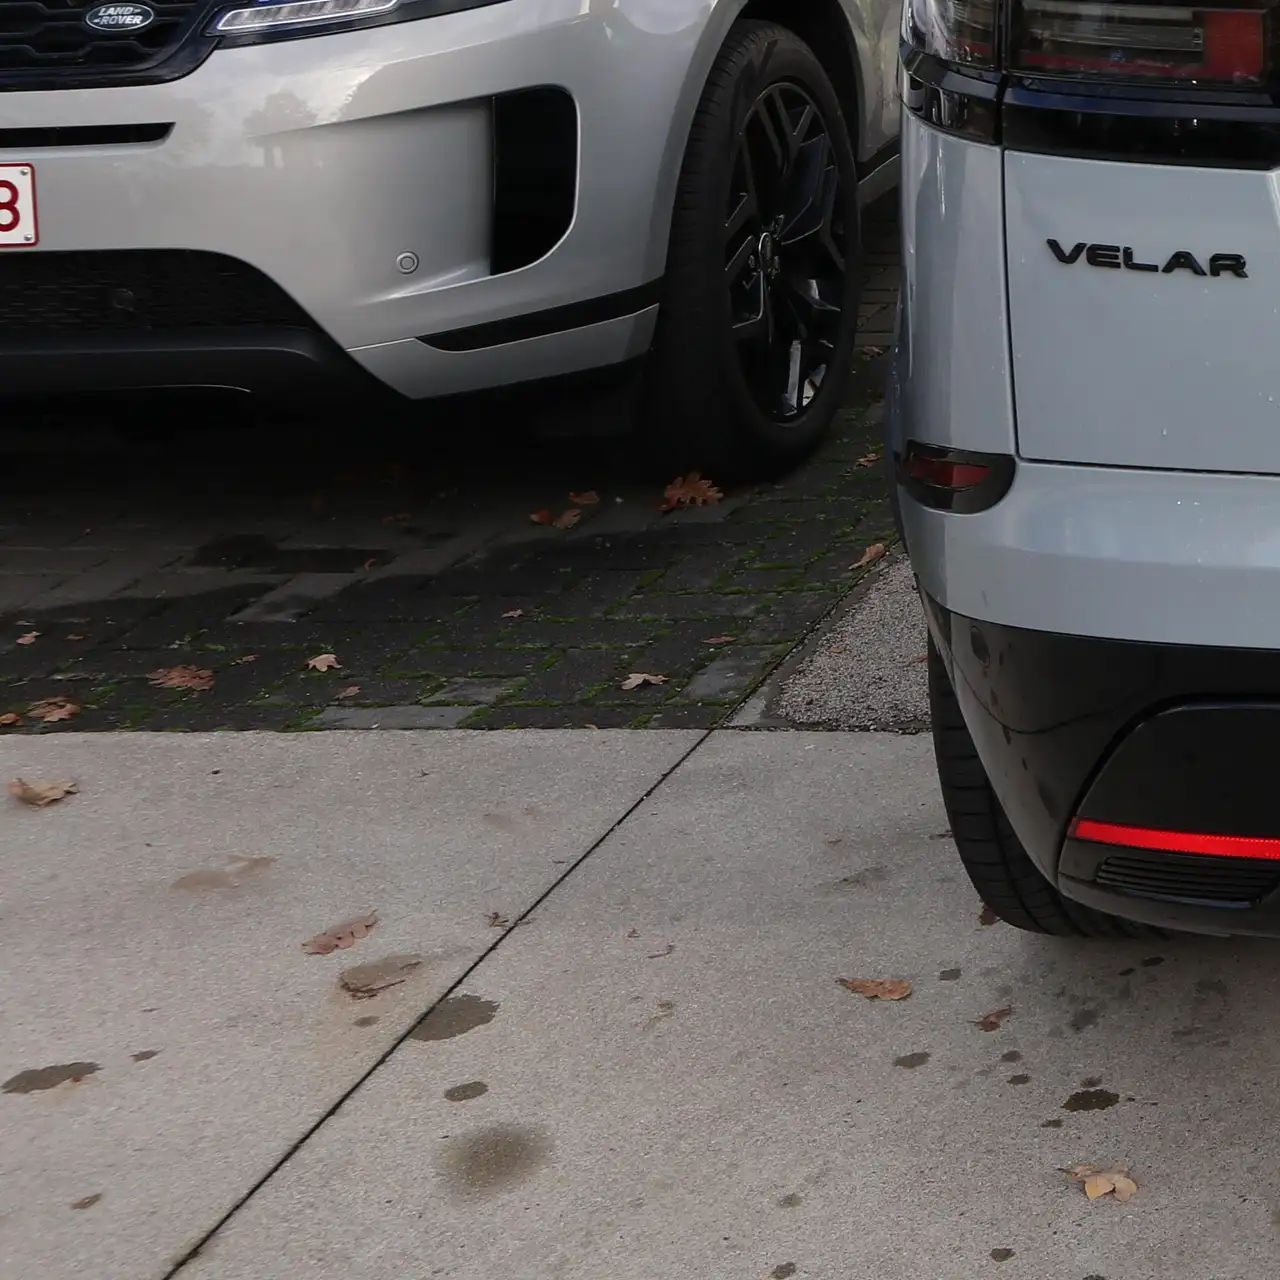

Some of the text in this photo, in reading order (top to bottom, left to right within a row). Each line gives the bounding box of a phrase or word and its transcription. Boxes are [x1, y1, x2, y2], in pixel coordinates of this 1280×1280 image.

[98, 7, 136, 16] LAND
[99, 15, 143, 25] ROVER
[1046, 238, 1249, 279] VELAR
